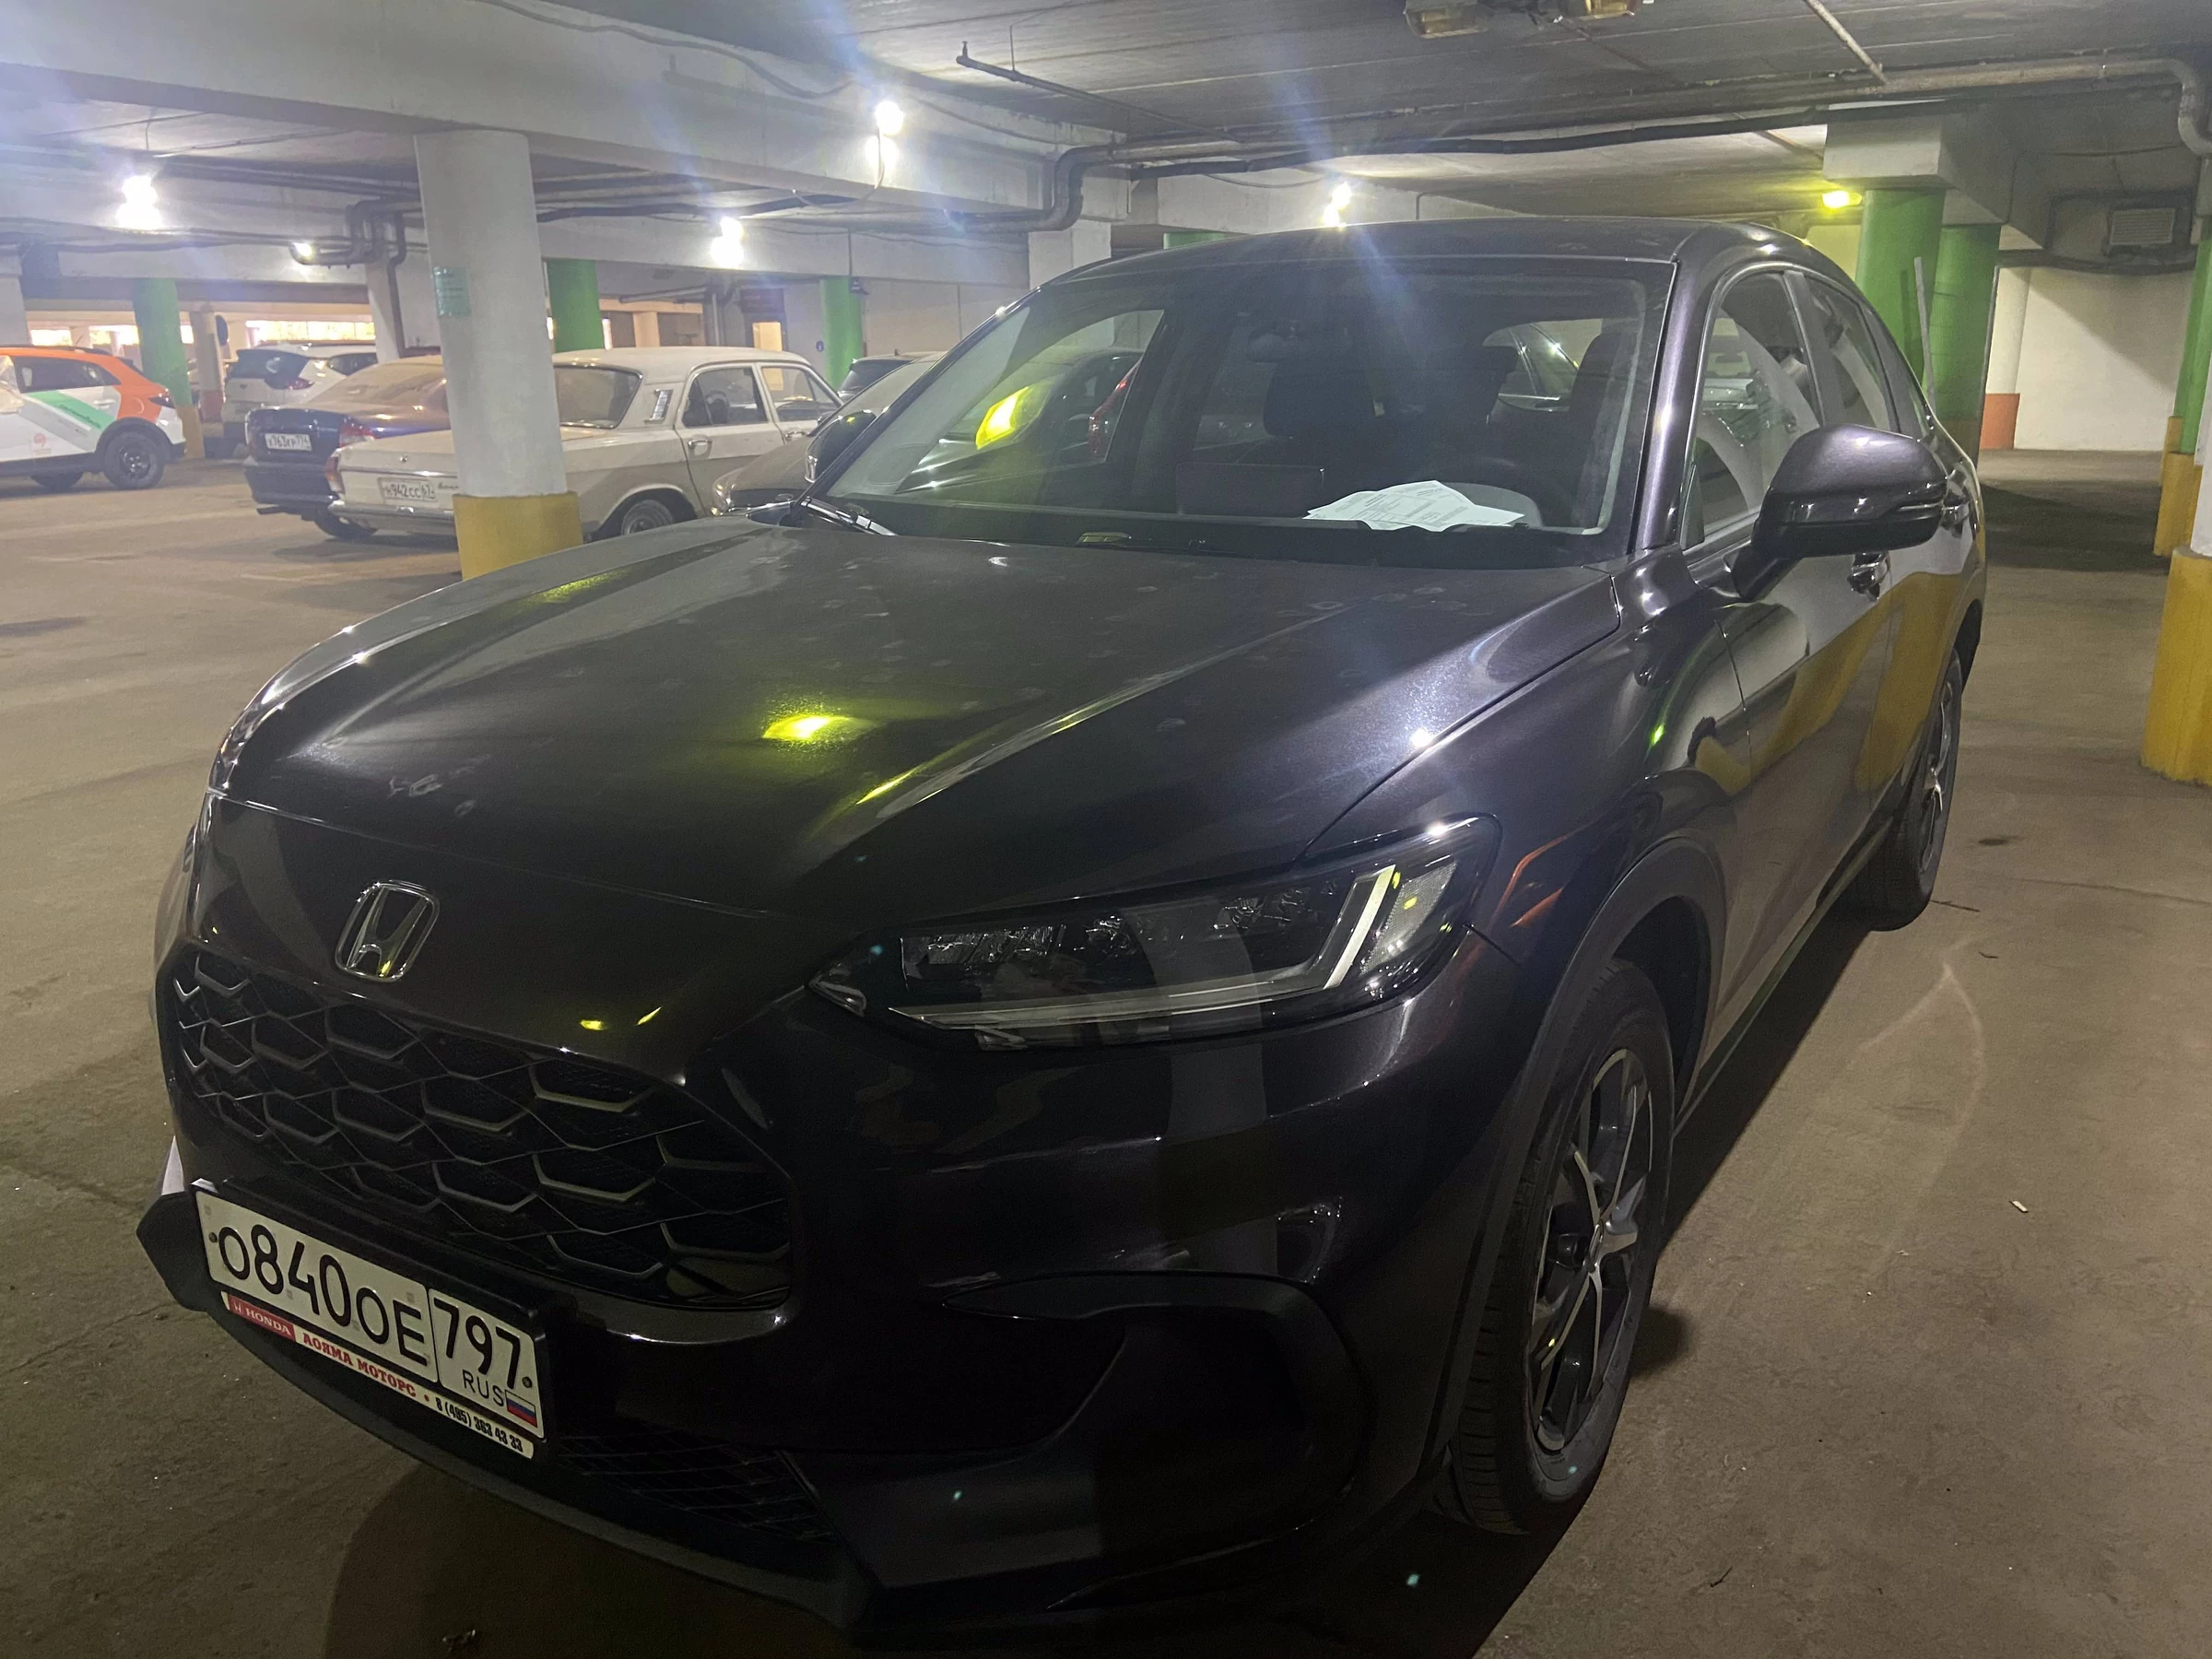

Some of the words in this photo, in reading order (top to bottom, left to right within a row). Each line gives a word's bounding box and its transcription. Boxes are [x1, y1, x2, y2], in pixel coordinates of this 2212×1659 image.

[245, 1307, 291, 1336] HONDA
[433, 1297, 521, 1390] 797
[302, 1332, 353, 1367] АОЯМА
[357, 1358, 417, 1397] МОТОРС
[435, 1396, 443, 1412] 8
[445, 1401, 472, 1427] (495)
[474, 1416, 493, 1438] 363
[494, 1427, 508, 1447] 43
[509, 1434, 524, 1453] 33
[462, 1369, 504, 1406] RUS
